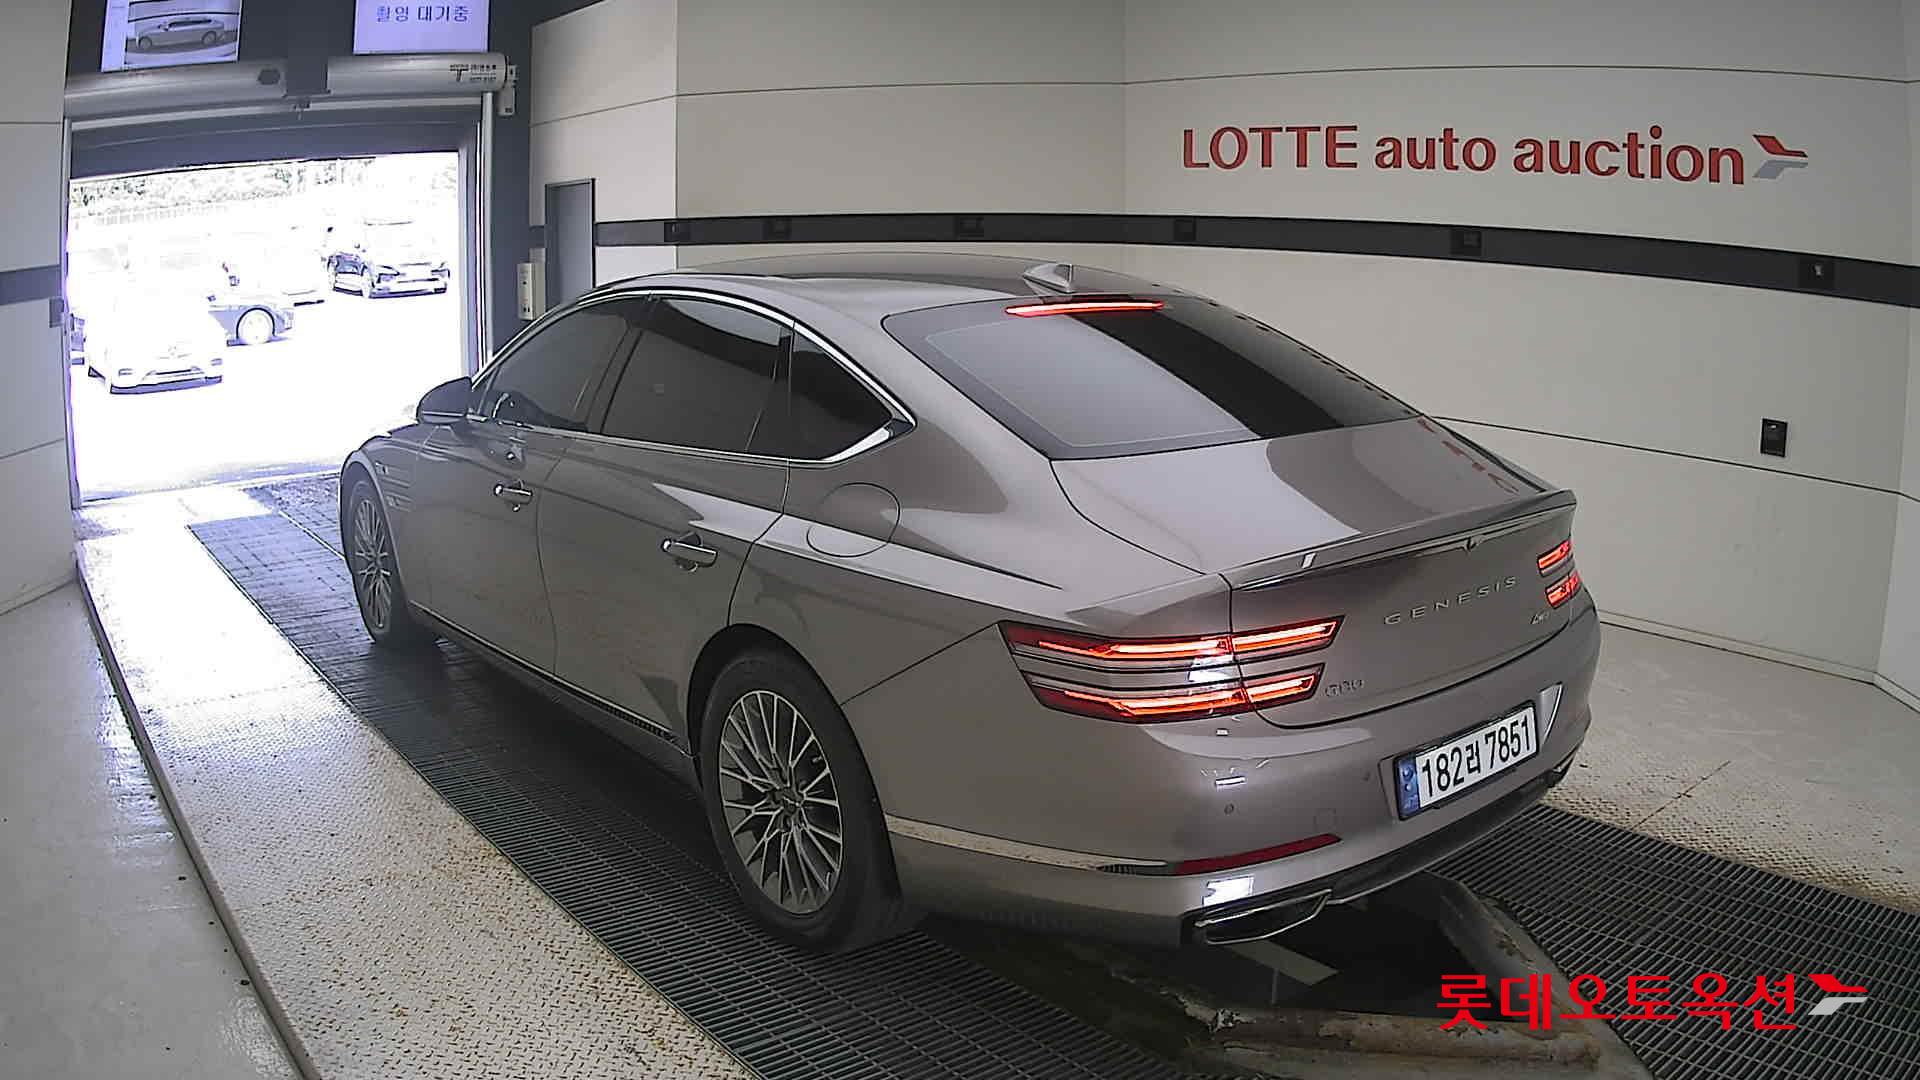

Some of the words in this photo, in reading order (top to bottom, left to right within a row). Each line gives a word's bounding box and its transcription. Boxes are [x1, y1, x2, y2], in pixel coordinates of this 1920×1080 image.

[417, 5, 472, 22] 대기중
[1183, 125, 1358, 170] LOTTE
[1374, 127, 1497, 172] auto
[1513, 125, 1745, 185] auction
[1384, 576, 1517, 625] GENESIS
[1484, 714, 1531, 769] 7851
